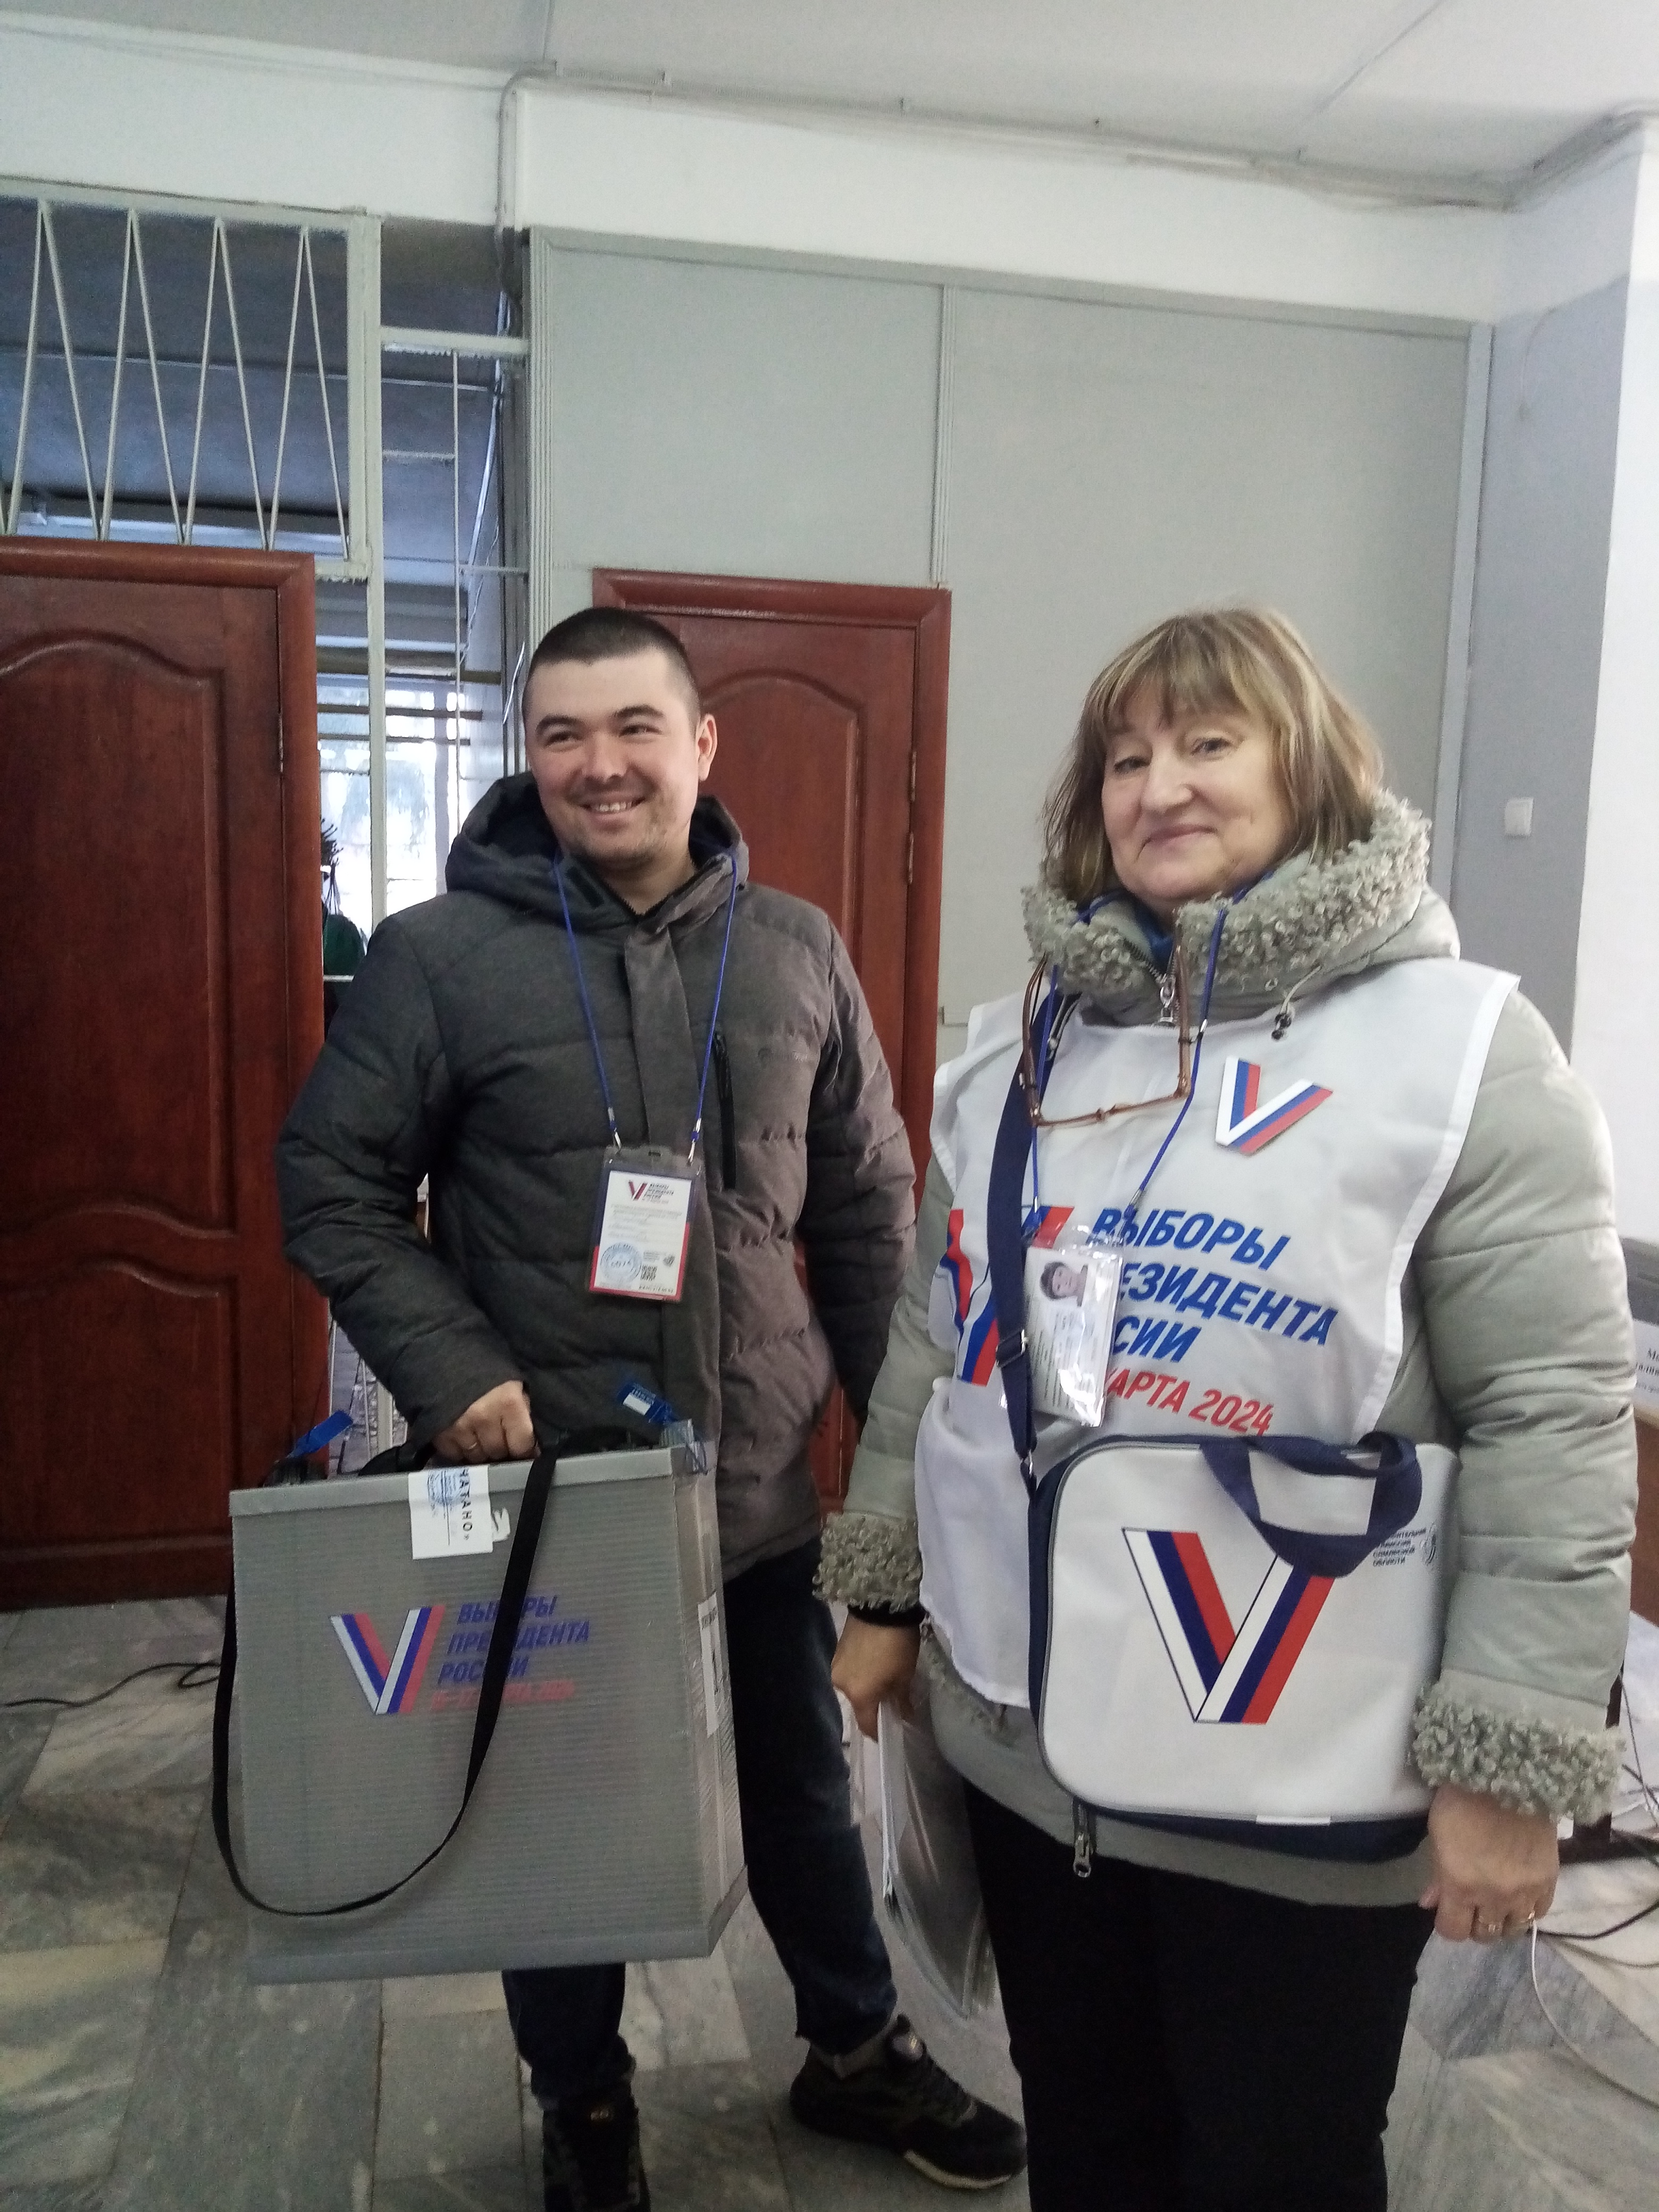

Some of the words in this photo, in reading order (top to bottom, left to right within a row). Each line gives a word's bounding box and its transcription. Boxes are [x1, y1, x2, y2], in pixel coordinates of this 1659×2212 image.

[1086, 1208, 1292, 1271] ВЫБОРЫ
[1120, 1262, 1339, 1346] ЕЗИДЕНТА
[1112, 1316, 1202, 1364] СИИ
[1105, 1368, 1191, 1414] АРТА
[1188, 1389, 1274, 1437] 2024
[457, 1595, 558, 1625] ВЫРЫ
[447, 1621, 590, 1655] ПРЕДЕНТА
